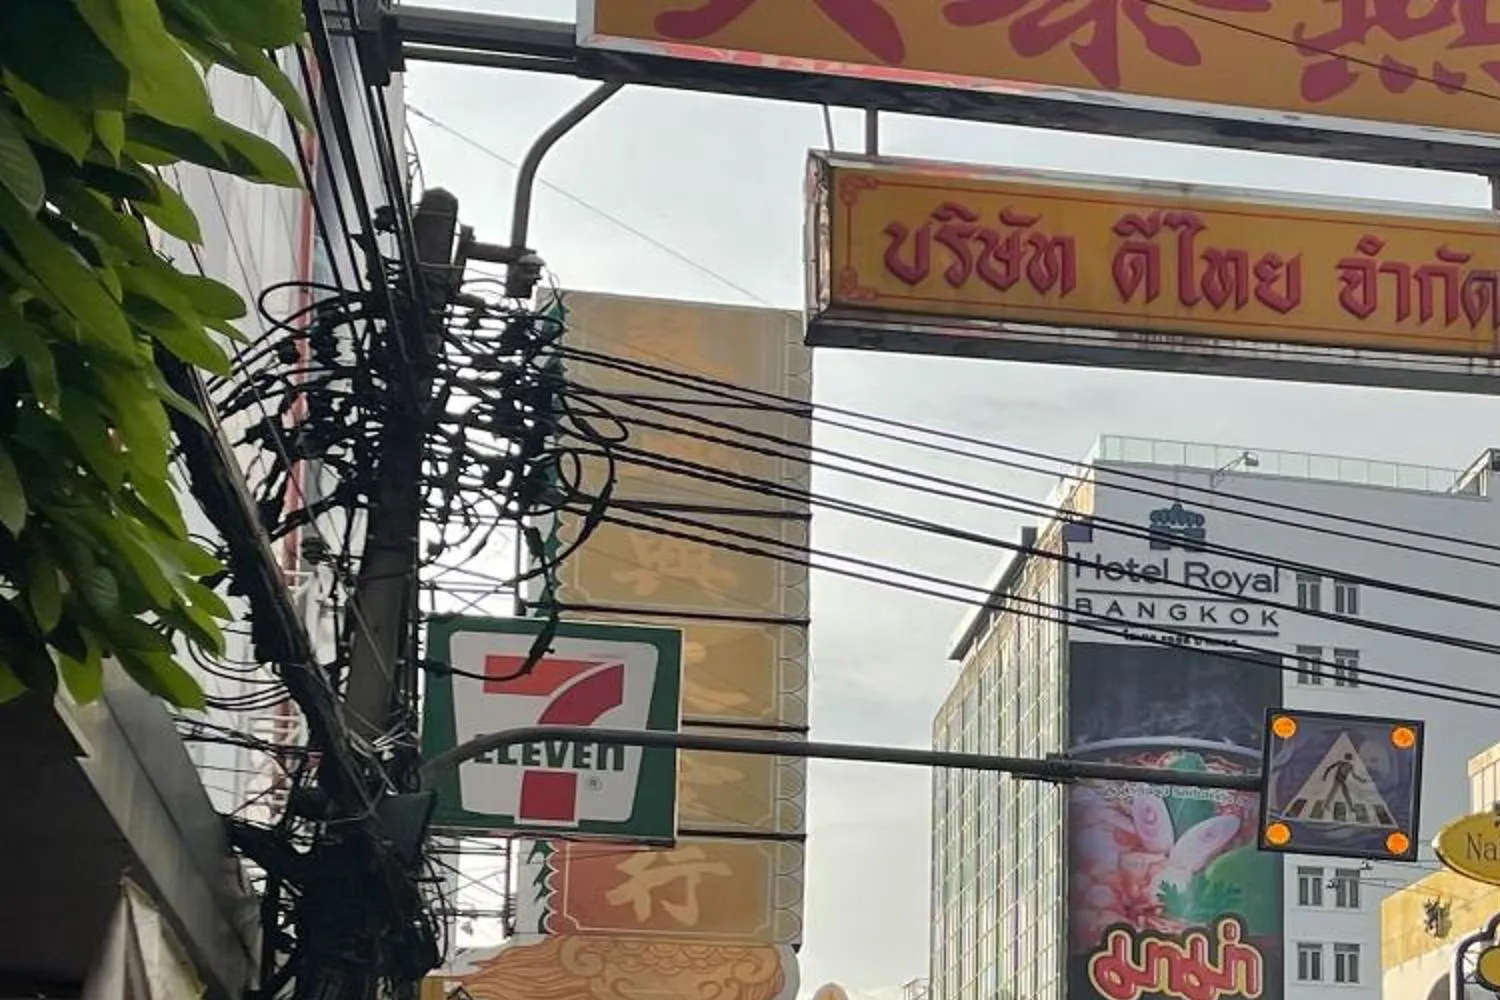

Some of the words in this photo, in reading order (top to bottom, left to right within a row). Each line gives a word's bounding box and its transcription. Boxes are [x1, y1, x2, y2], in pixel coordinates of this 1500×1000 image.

[882, 201, 1078, 298] บริษัท
[1111, 211, 1302, 313] ดีไทย
[1076, 552, 1169, 584] Hotel
[1184, 560, 1280, 595] Royal
[1075, 597, 1280, 627] BANGKOK
